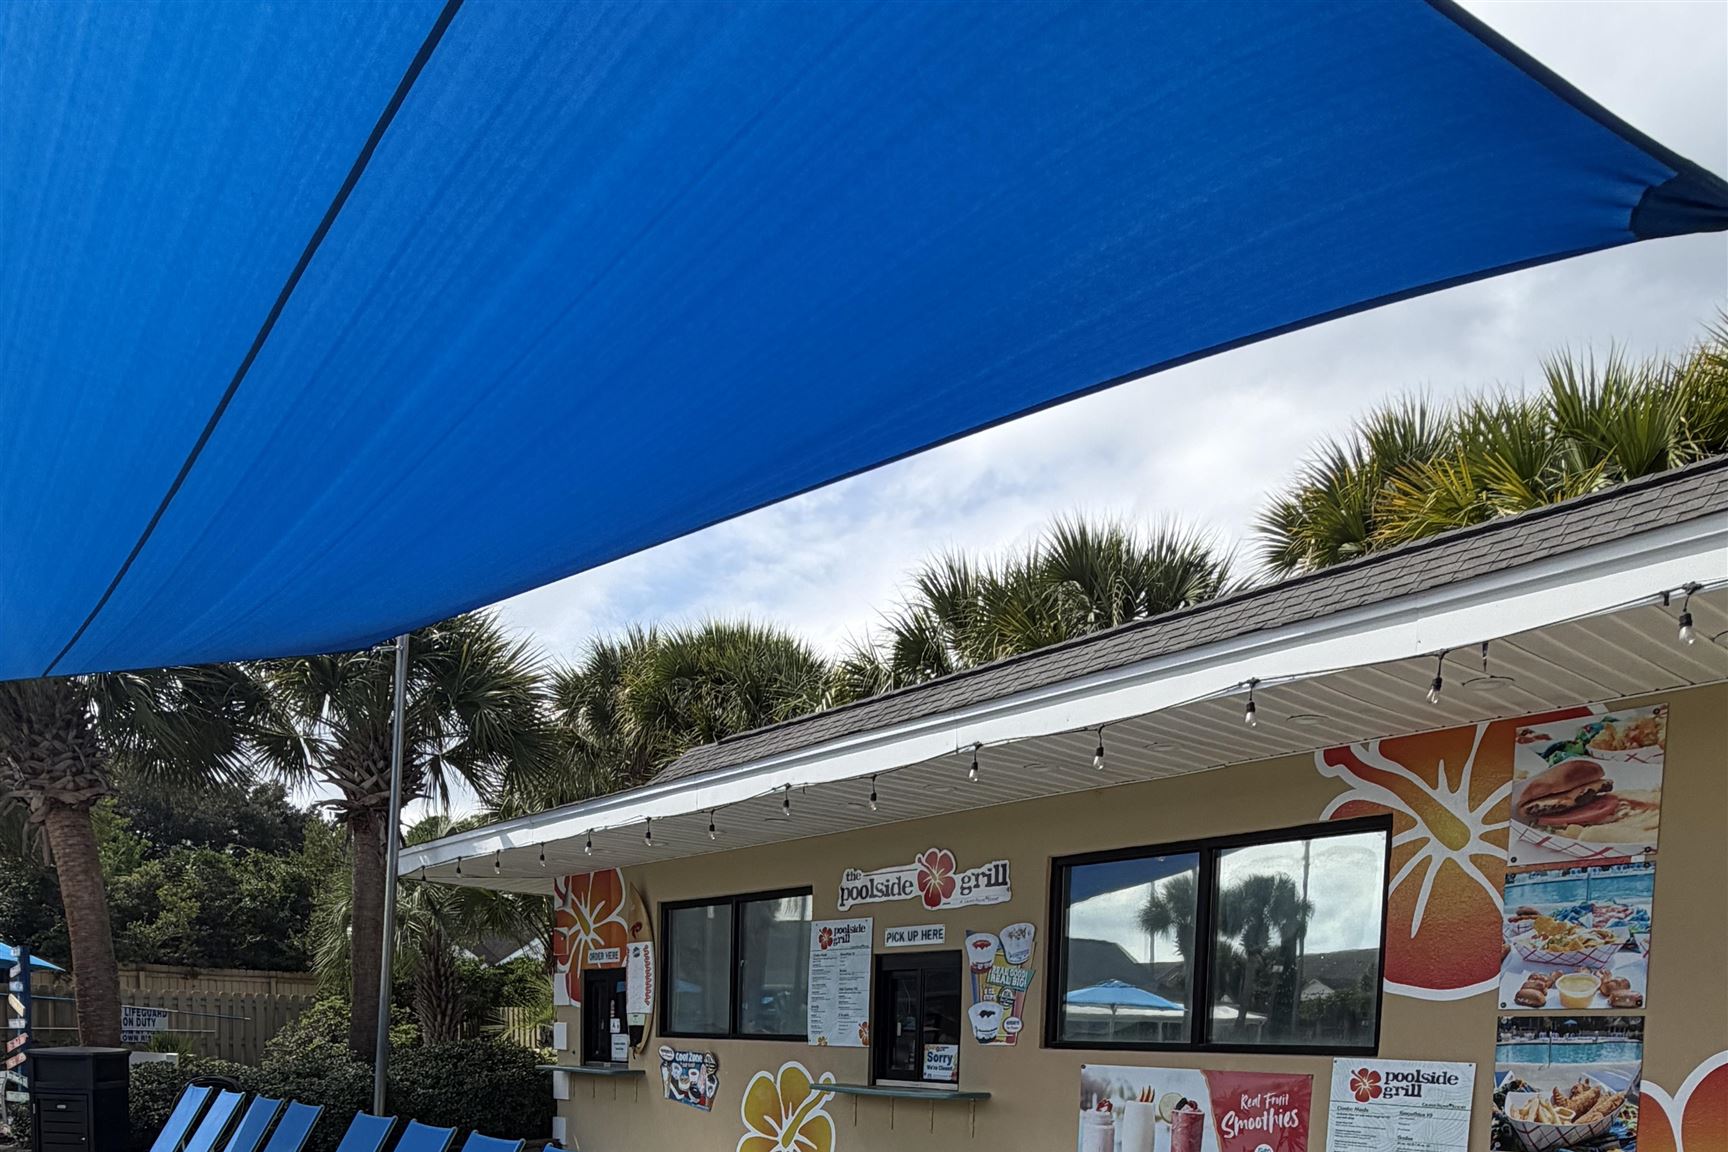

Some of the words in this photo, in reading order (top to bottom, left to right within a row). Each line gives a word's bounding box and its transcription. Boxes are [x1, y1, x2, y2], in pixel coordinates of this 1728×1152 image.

[845, 870, 861, 882] the
[840, 876, 914, 907] poolside
[960, 863, 1009, 895] grill
[833, 924, 866, 937] poolside
[886, 930, 905, 943] PICK
[907, 930, 919, 941] UP
[921, 928, 944, 941] HERE
[833, 934, 850, 946] grill
[589, 952, 604, 961] ORDER
[605, 950, 619, 960] HERE
[124, 1006, 168, 1018] LIFEGUARD
[122, 1017, 134, 1027] ON
[136, 1018, 157, 1027] DUTY
[675, 1052, 689, 1061] Cool
[927, 1051, 953, 1066] Sorry
[1384, 1069, 1459, 1086] poolside
[1383, 1084, 1422, 1098] grill
[1240, 1093, 1261, 1111] Real
[1263, 1092, 1289, 1110] Fruit
[1221, 1107, 1299, 1138] Smoothies
